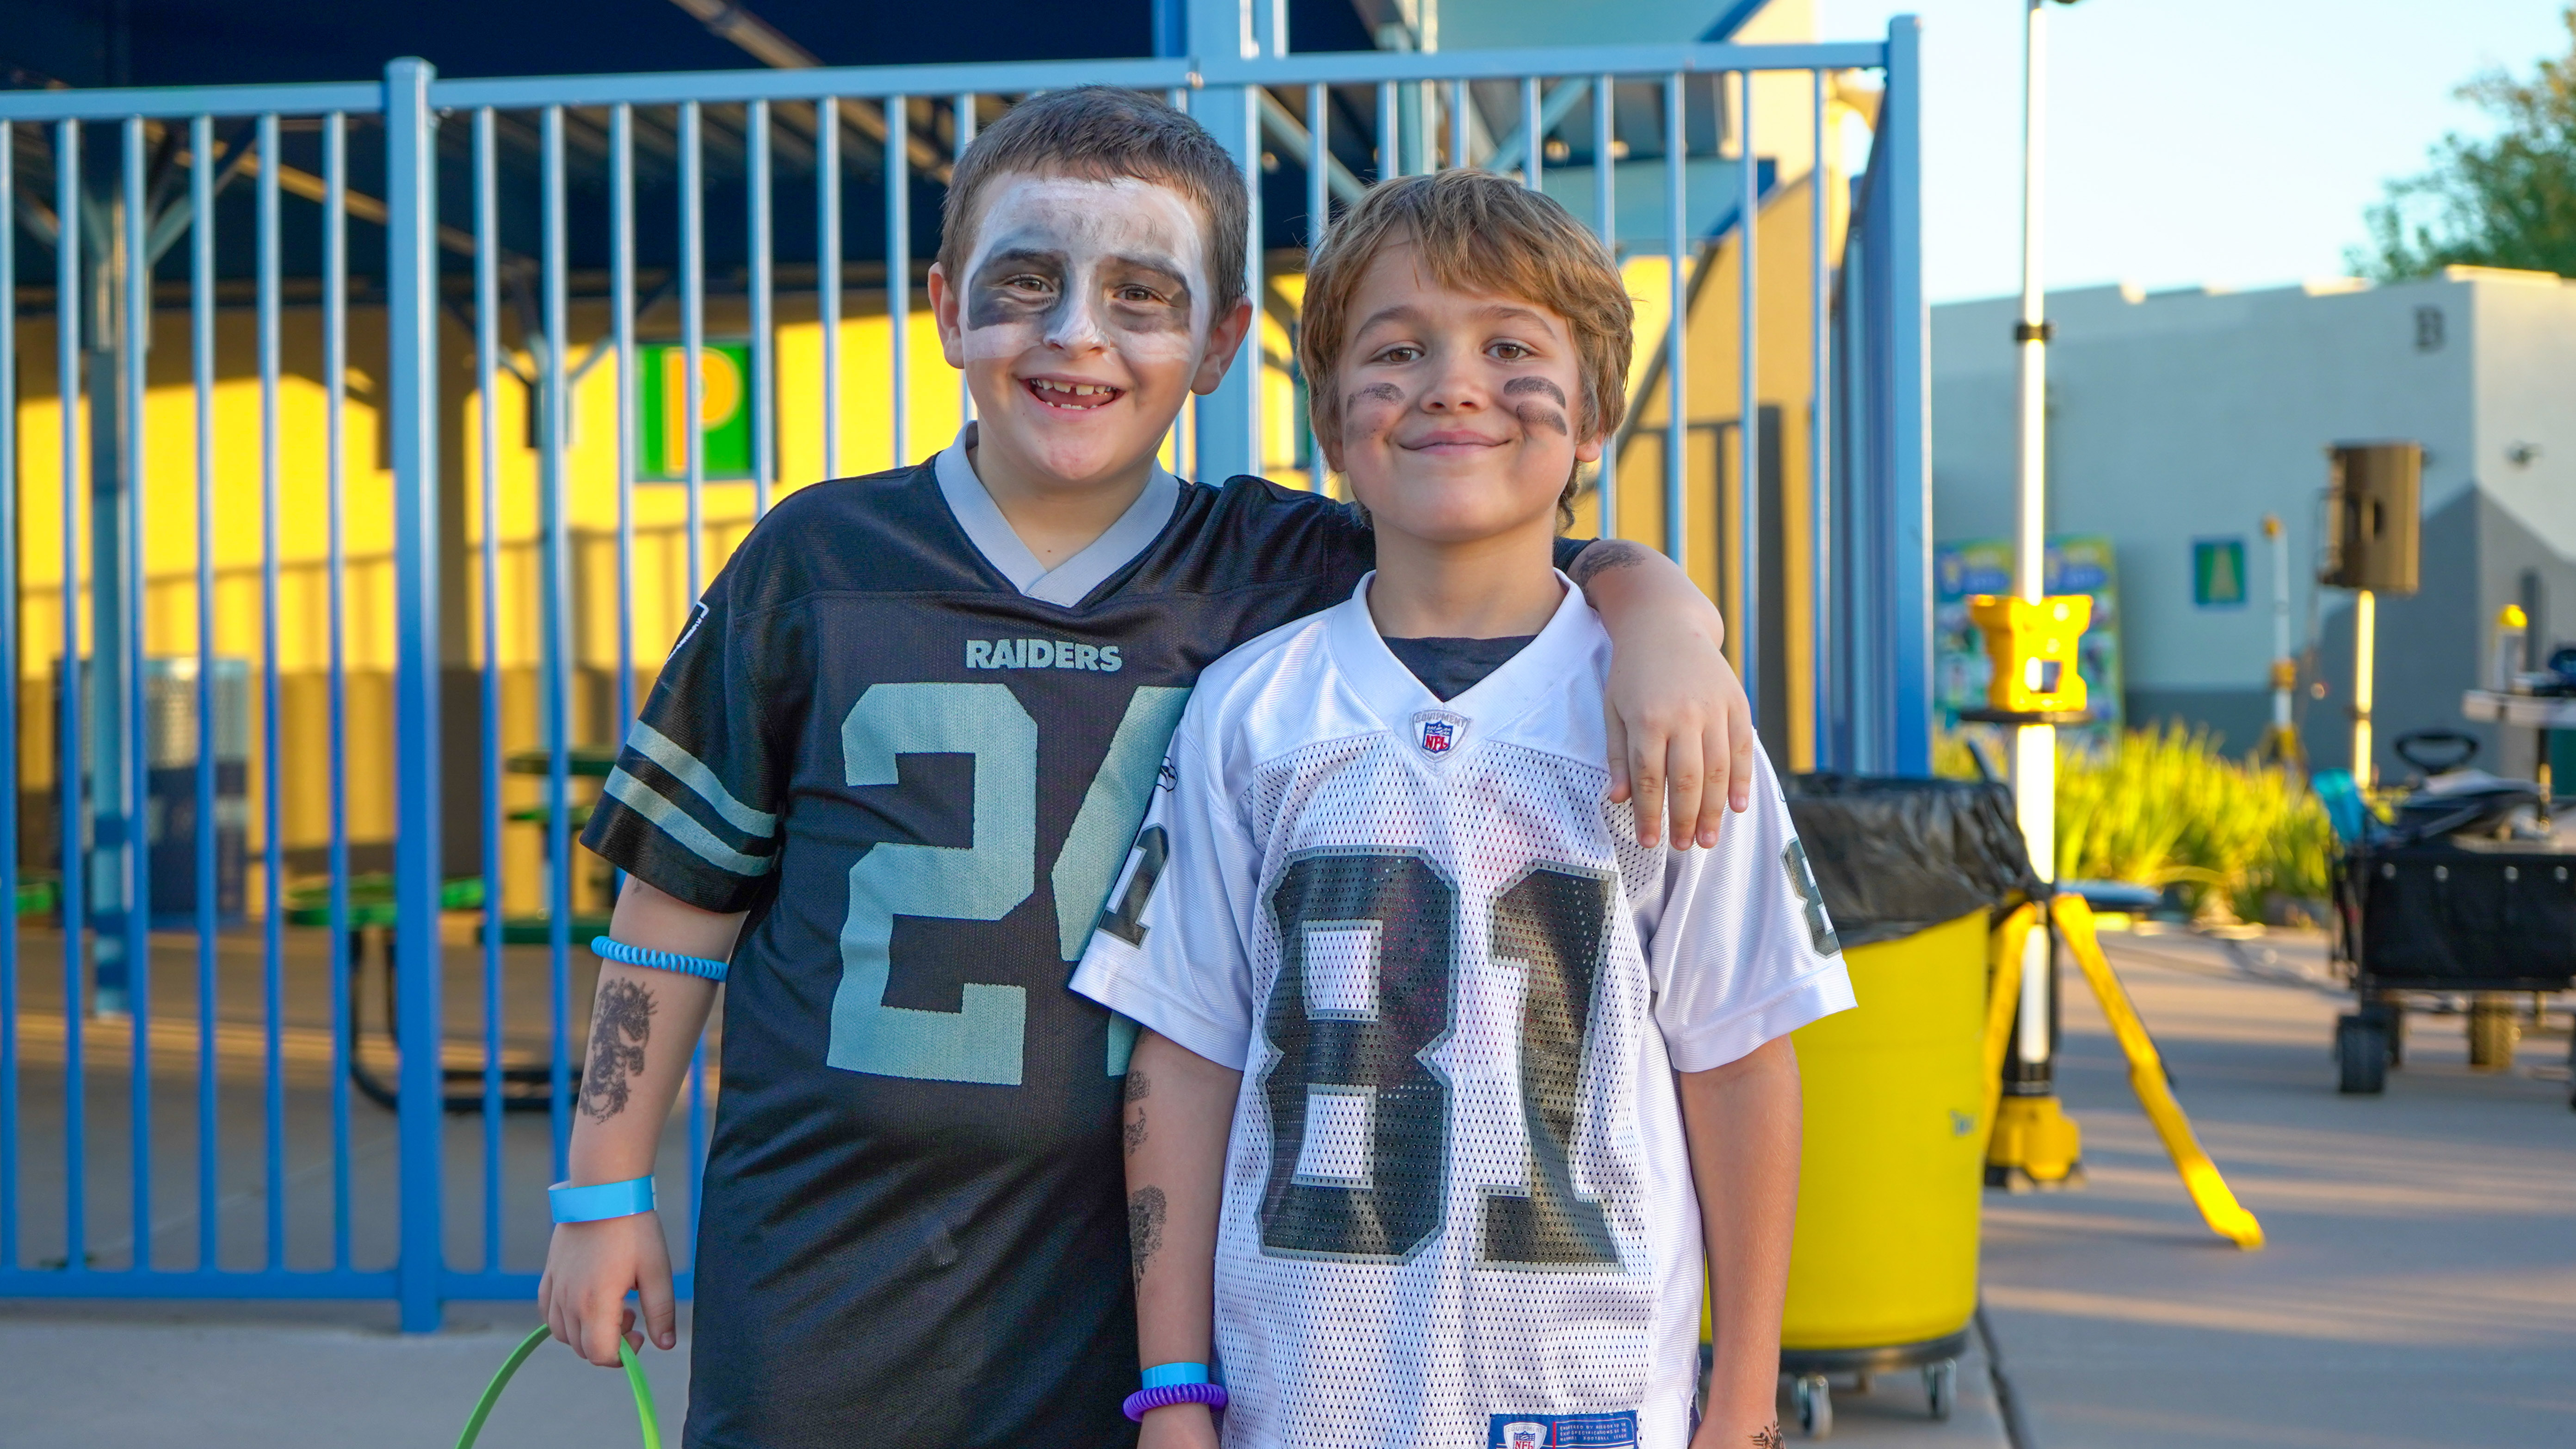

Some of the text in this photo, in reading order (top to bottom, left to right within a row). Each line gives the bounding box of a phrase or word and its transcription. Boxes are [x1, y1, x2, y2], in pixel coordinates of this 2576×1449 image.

[2414, 305, 2445, 353] B
[661, 346, 743, 478] P
[966, 639, 1122, 672] RAIDERS
[1415, 711, 1466, 727] EQUIPMENT
[1425, 734, 1449, 751] NFL
[1254, 845, 1627, 1273] 81
[1515, 1441, 1533, 1449] NFL
